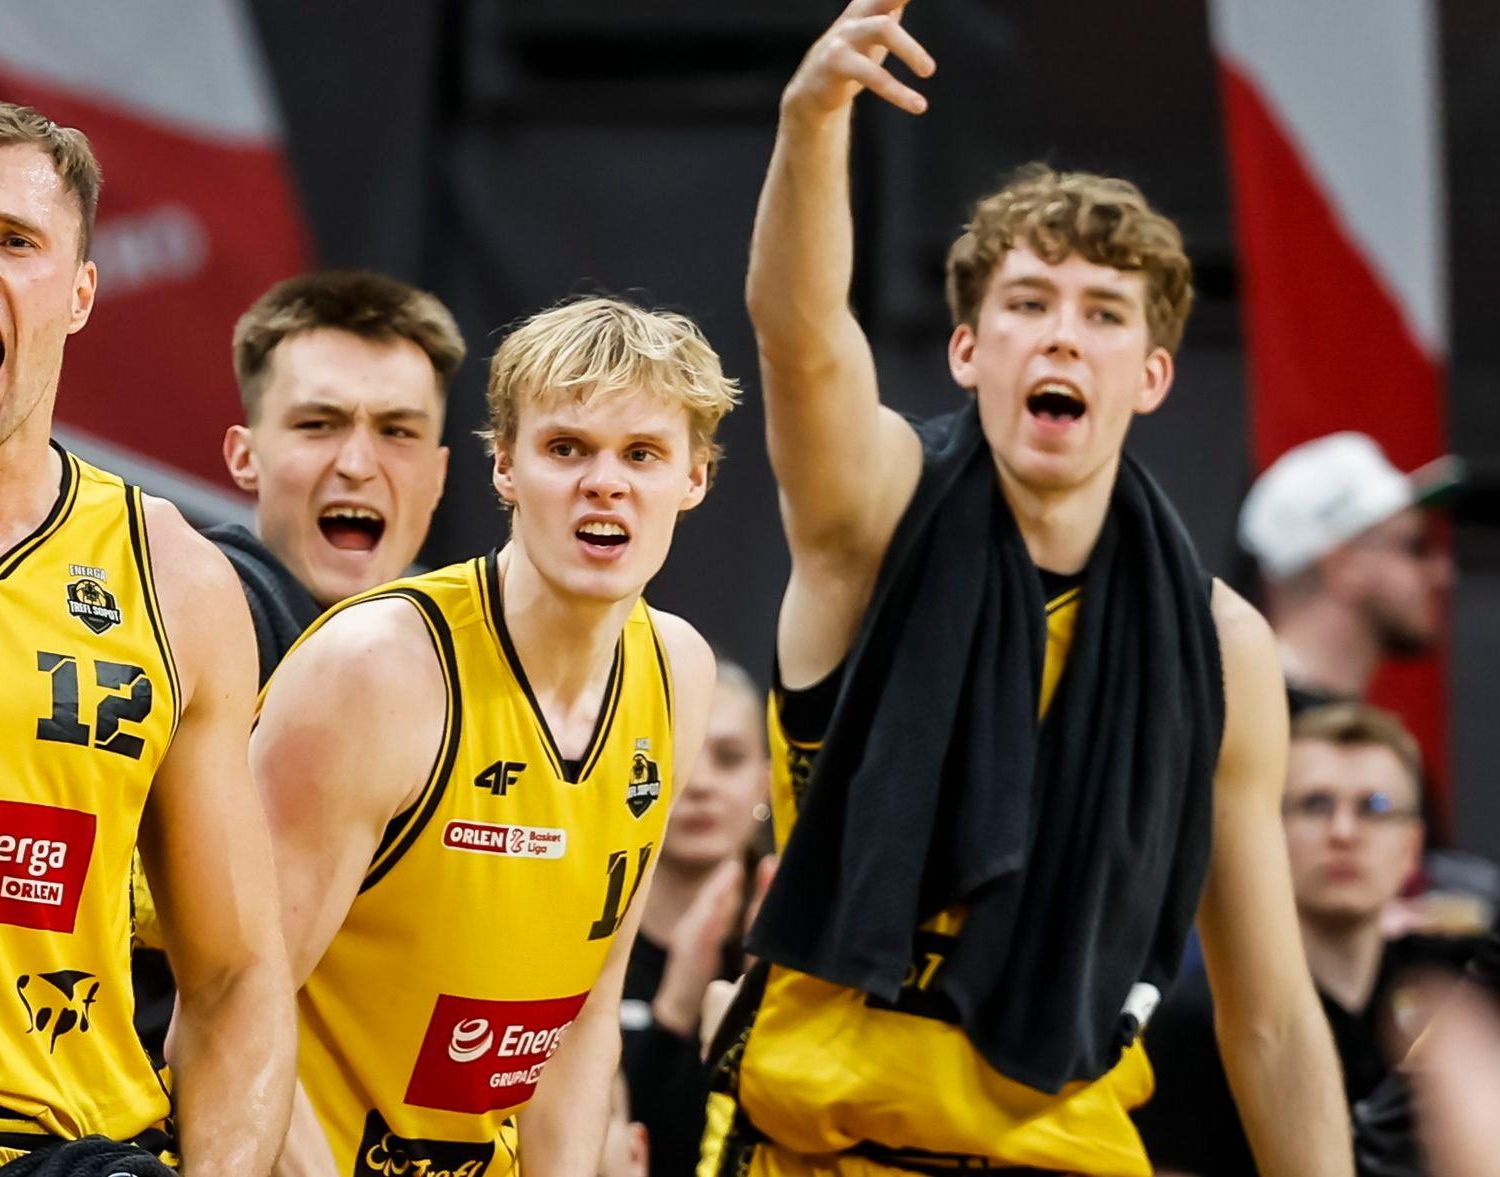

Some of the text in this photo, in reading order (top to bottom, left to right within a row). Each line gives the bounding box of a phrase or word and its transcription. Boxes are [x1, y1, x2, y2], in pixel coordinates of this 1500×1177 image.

[36, 650, 152, 760] 12
[474, 760, 527, 795] 4F
[450, 827, 505, 847] ORLEN
[528, 843, 547, 854] Liga
[5, 880, 60, 902] ORLEN
[497, 1020, 573, 1058] Energ
